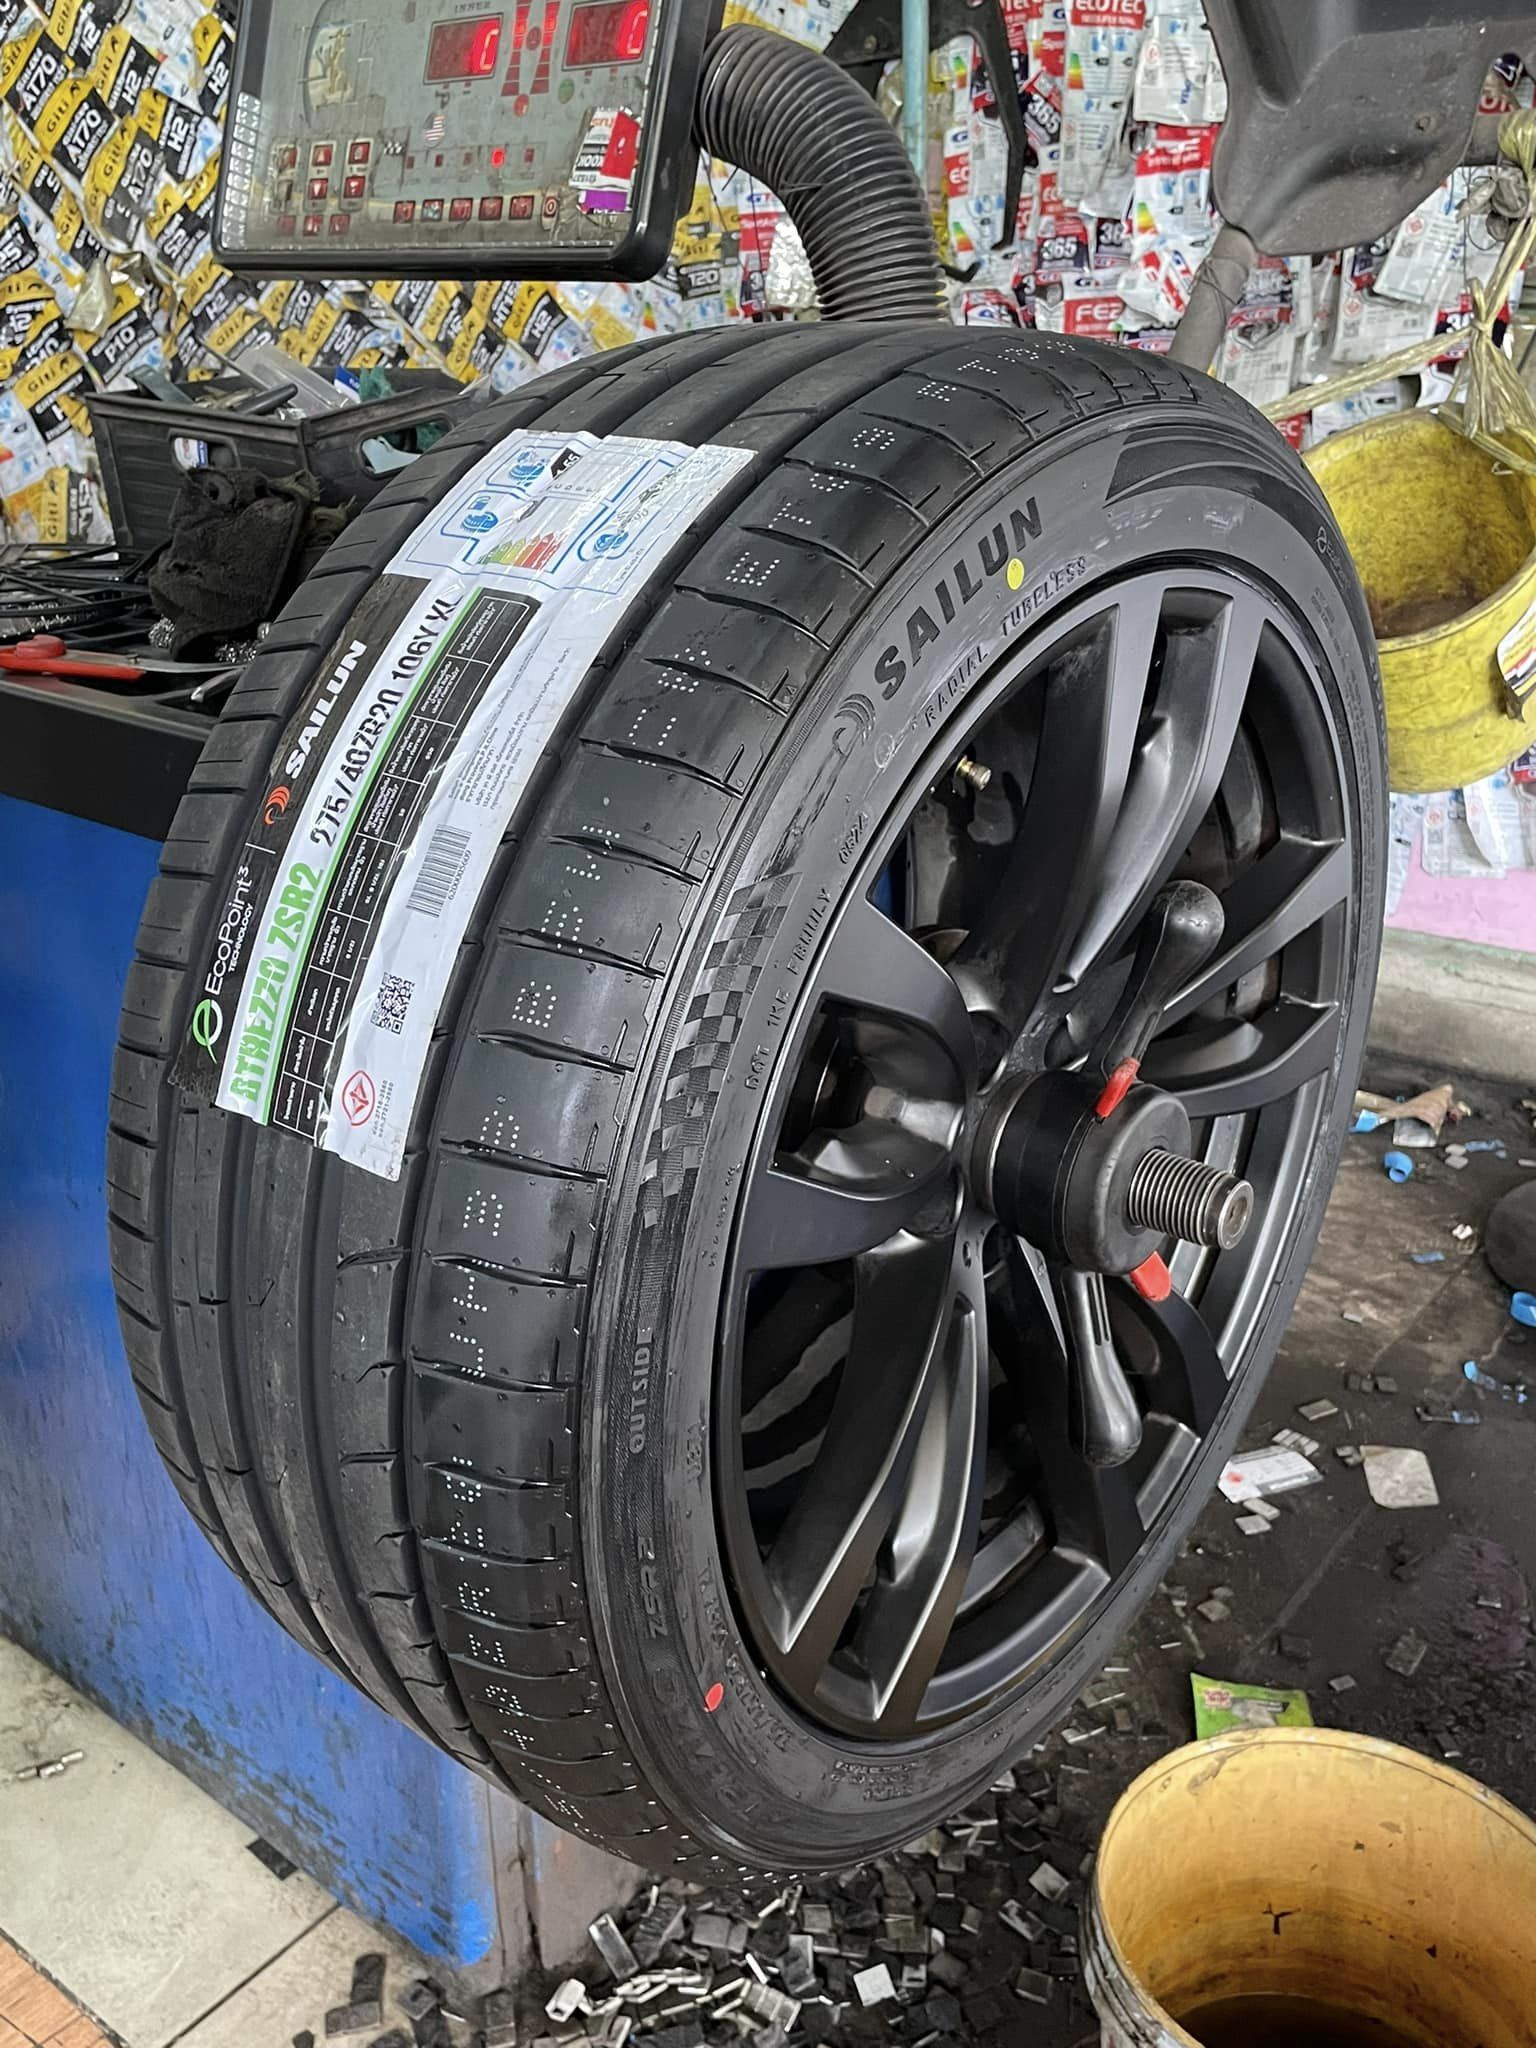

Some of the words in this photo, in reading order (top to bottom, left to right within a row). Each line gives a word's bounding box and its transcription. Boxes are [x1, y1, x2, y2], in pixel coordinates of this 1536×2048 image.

[80, 20, 101, 56] H2
[22, 53, 57, 111] AT70
[121, 70, 142, 106] H2
[207, 61, 229, 96] H2
[66, 109, 101, 163] AT70
[167, 117, 190, 152] H2
[1028, 93, 1062, 134] 365
[128, 147, 153, 203] AT70
[1043, 235, 1078, 259] 365
[205, 292, 229, 320] H2
[532, 308, 552, 338] H2
[104, 326, 136, 363] P10
[874, 496, 1043, 701] SAILUN
[924, 643, 990, 728] RADIAL
[1000, 555, 1087, 636] TUBELESS
[285, 639, 368, 779] SAILUN
[230, 956, 290, 1102] ATREZZO
[267, 862, 324, 952] ZSR2
[310, 688, 404, 847] 275/40ZR20
[391, 624, 438, 681] 106Y
[425, 594, 465, 622] XL
[228, 903, 255, 972] TECHNOLOGY
[744, 1044, 771, 1091] DOT
[629, 1326, 654, 1455] OUTSIDE
[635, 1536, 668, 1640] ZSR2
